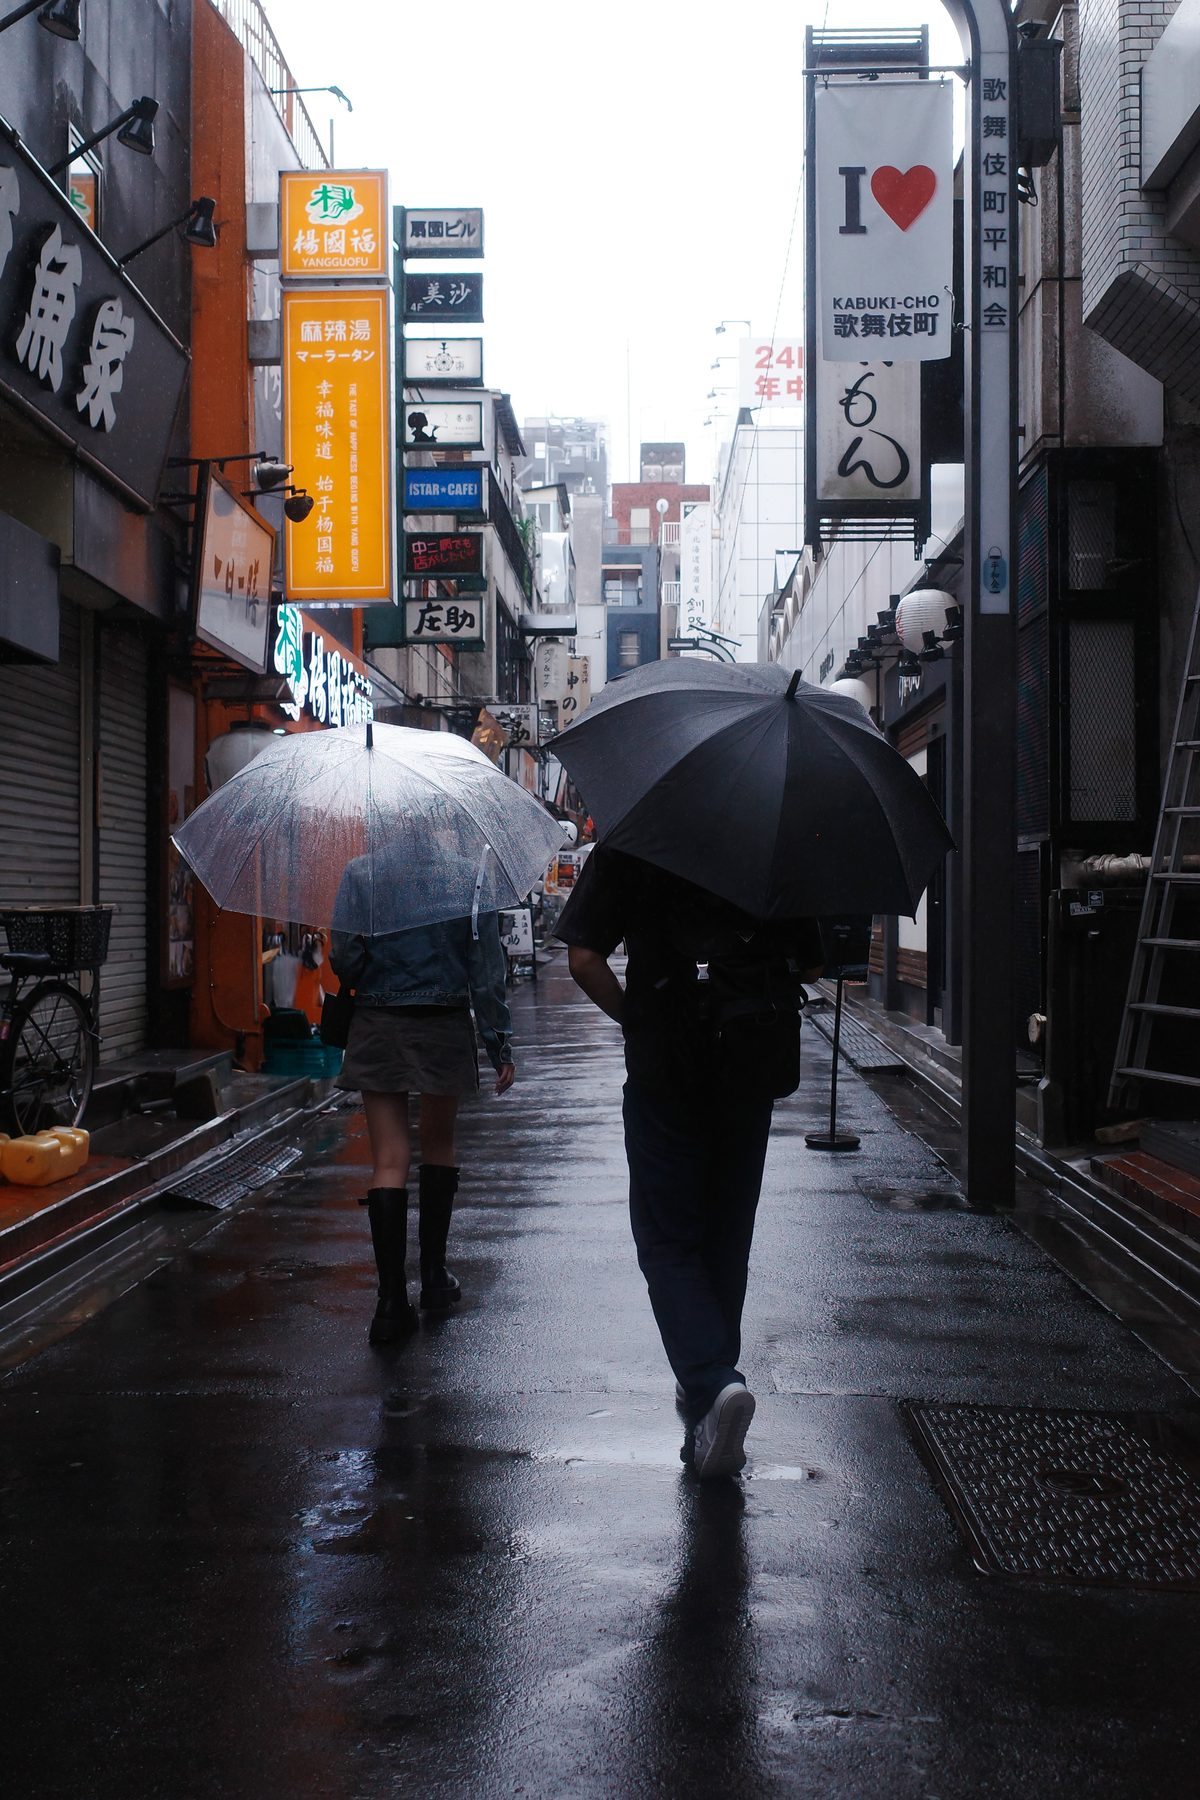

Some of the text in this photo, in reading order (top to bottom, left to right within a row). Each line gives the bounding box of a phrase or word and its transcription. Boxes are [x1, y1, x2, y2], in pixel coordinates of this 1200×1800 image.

[839, 166, 867, 234] I
[982, 78, 1008, 327] 歌舞伎町平和会
[293, 228, 377, 255] 楊國福
[302, 257, 369, 267] YANGGUOFU
[422, 282, 472, 305] 美沙
[833, 295, 939, 310] KABUKI-CHO
[410, 302, 424, 312] 4F
[301, 319, 371, 342] 麻辣湯
[833, 312, 939, 338] 歌舞伎町
[296, 349, 375, 362] マーラータン
[755, 345, 803, 369] 24
[838, 361, 910, 489] もん
